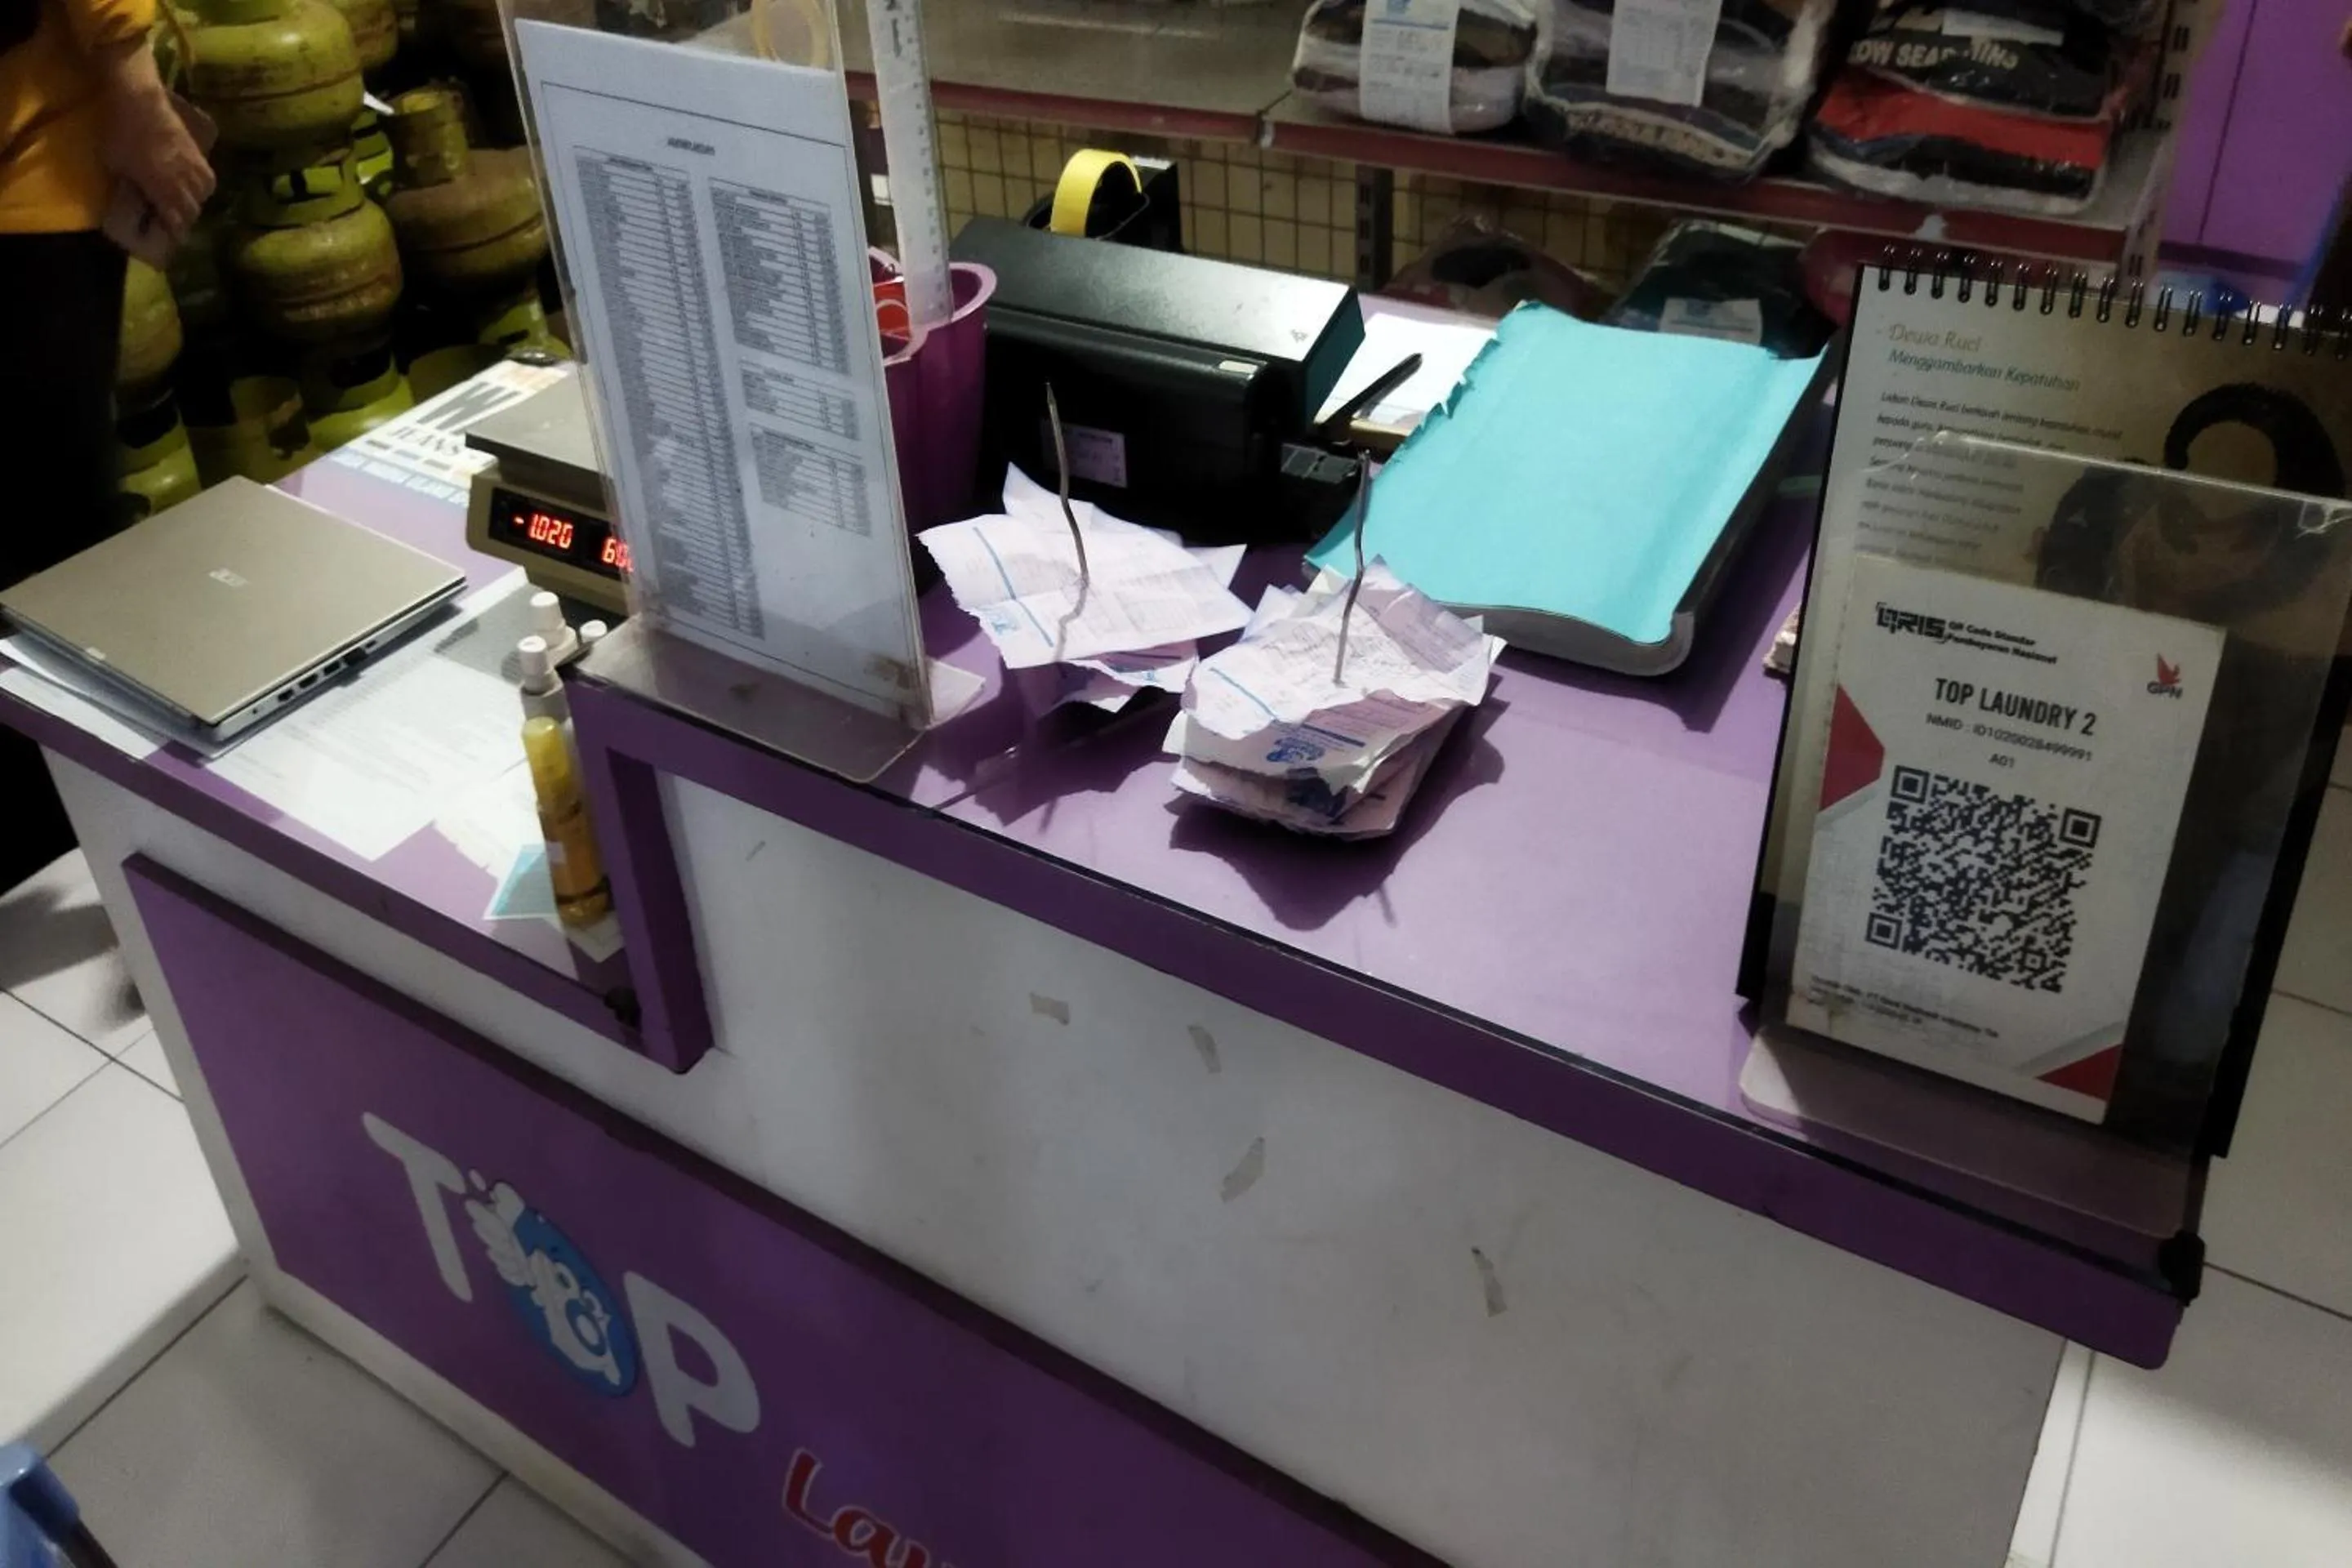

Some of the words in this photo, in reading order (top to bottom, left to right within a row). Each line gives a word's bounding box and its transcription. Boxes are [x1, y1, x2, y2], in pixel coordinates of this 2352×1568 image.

[1888, 348, 2002, 379] Menggambarkan
[2003, 364, 2081, 393] Kepatuhan
[1876, 604, 1947, 641] QRIS
[1966, 623, 1993, 638] Code
[1936, 677, 1974, 706] TOP
[1980, 690, 2078, 732] LAUNDRY
[2080, 712, 2098, 737] 2
[1926, 712, 1963, 731] NMID
[1988, 752, 2015, 768] A01
